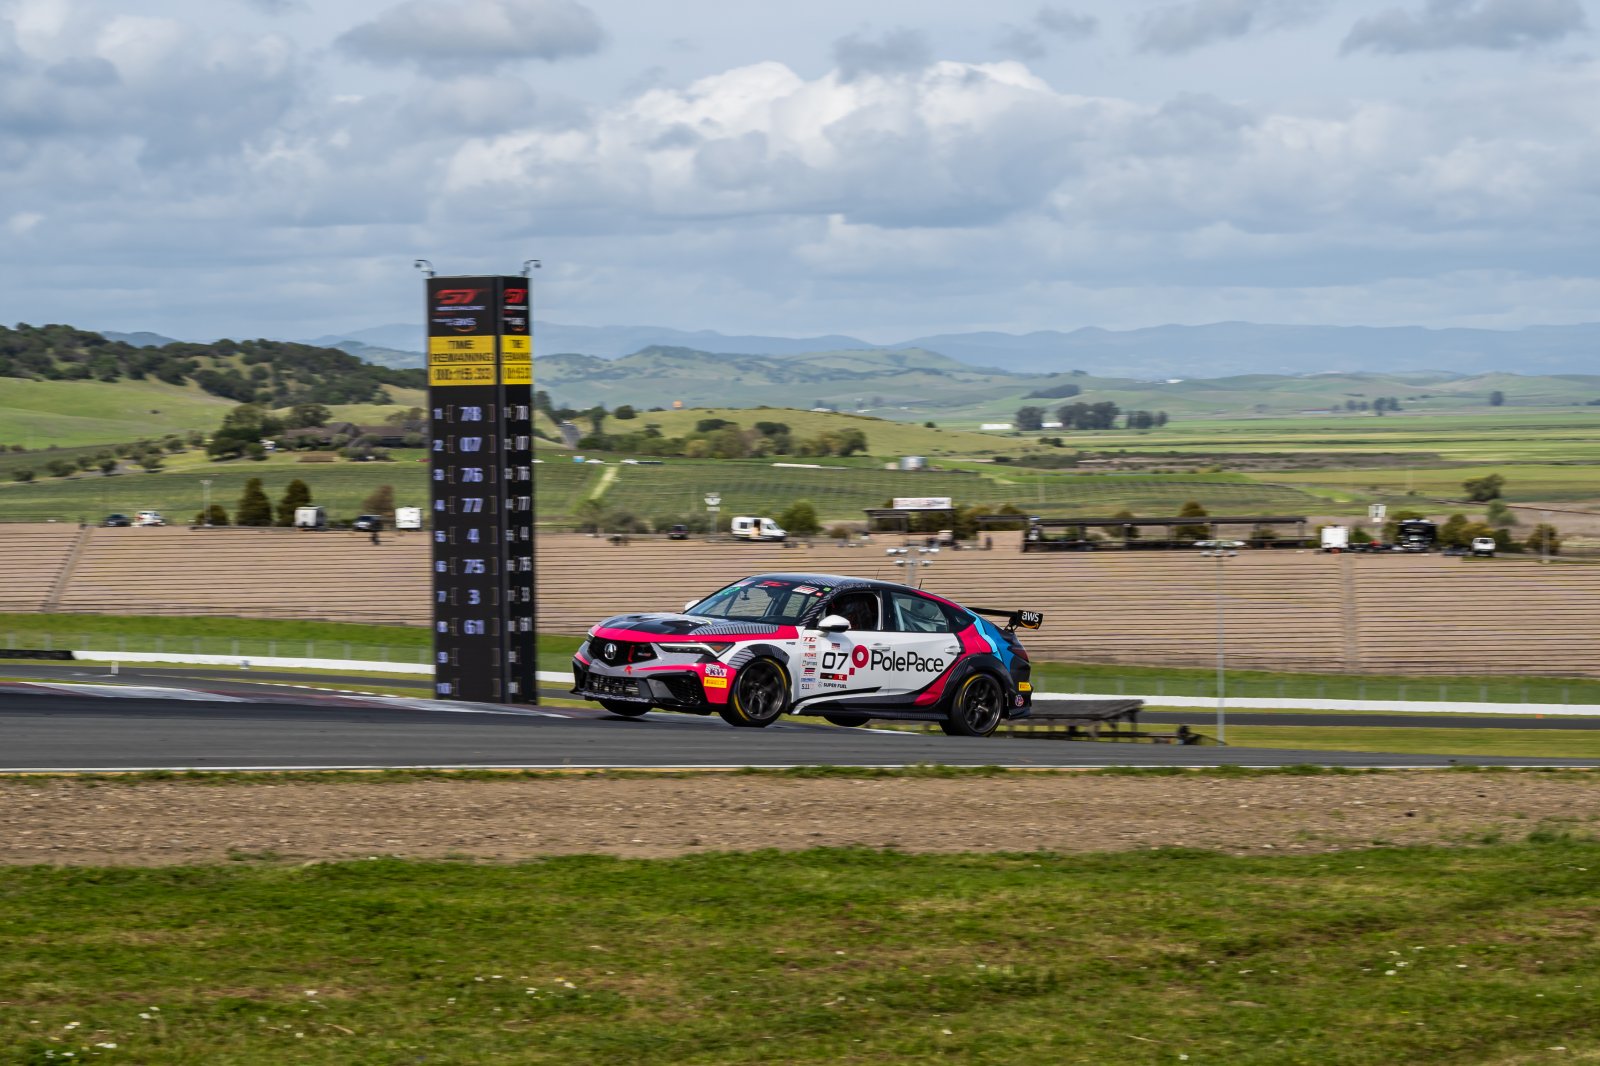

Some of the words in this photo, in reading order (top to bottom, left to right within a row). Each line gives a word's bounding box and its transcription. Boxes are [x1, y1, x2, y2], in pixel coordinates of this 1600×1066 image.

[447, 340, 475, 350] TIME
[433, 440, 444, 451] 2
[459, 437, 482, 452] 07
[433, 469, 445, 481] 3
[461, 498, 484, 513] 77
[435, 531, 446, 542] 5
[467, 529, 480, 543] 4
[462, 559, 486, 574] 75
[468, 590, 480, 604] 3
[1021, 611, 1040, 622] aws
[464, 620, 485, 635] 61
[822, 652, 849, 670] 07
[870, 650, 944, 673] PolePace
